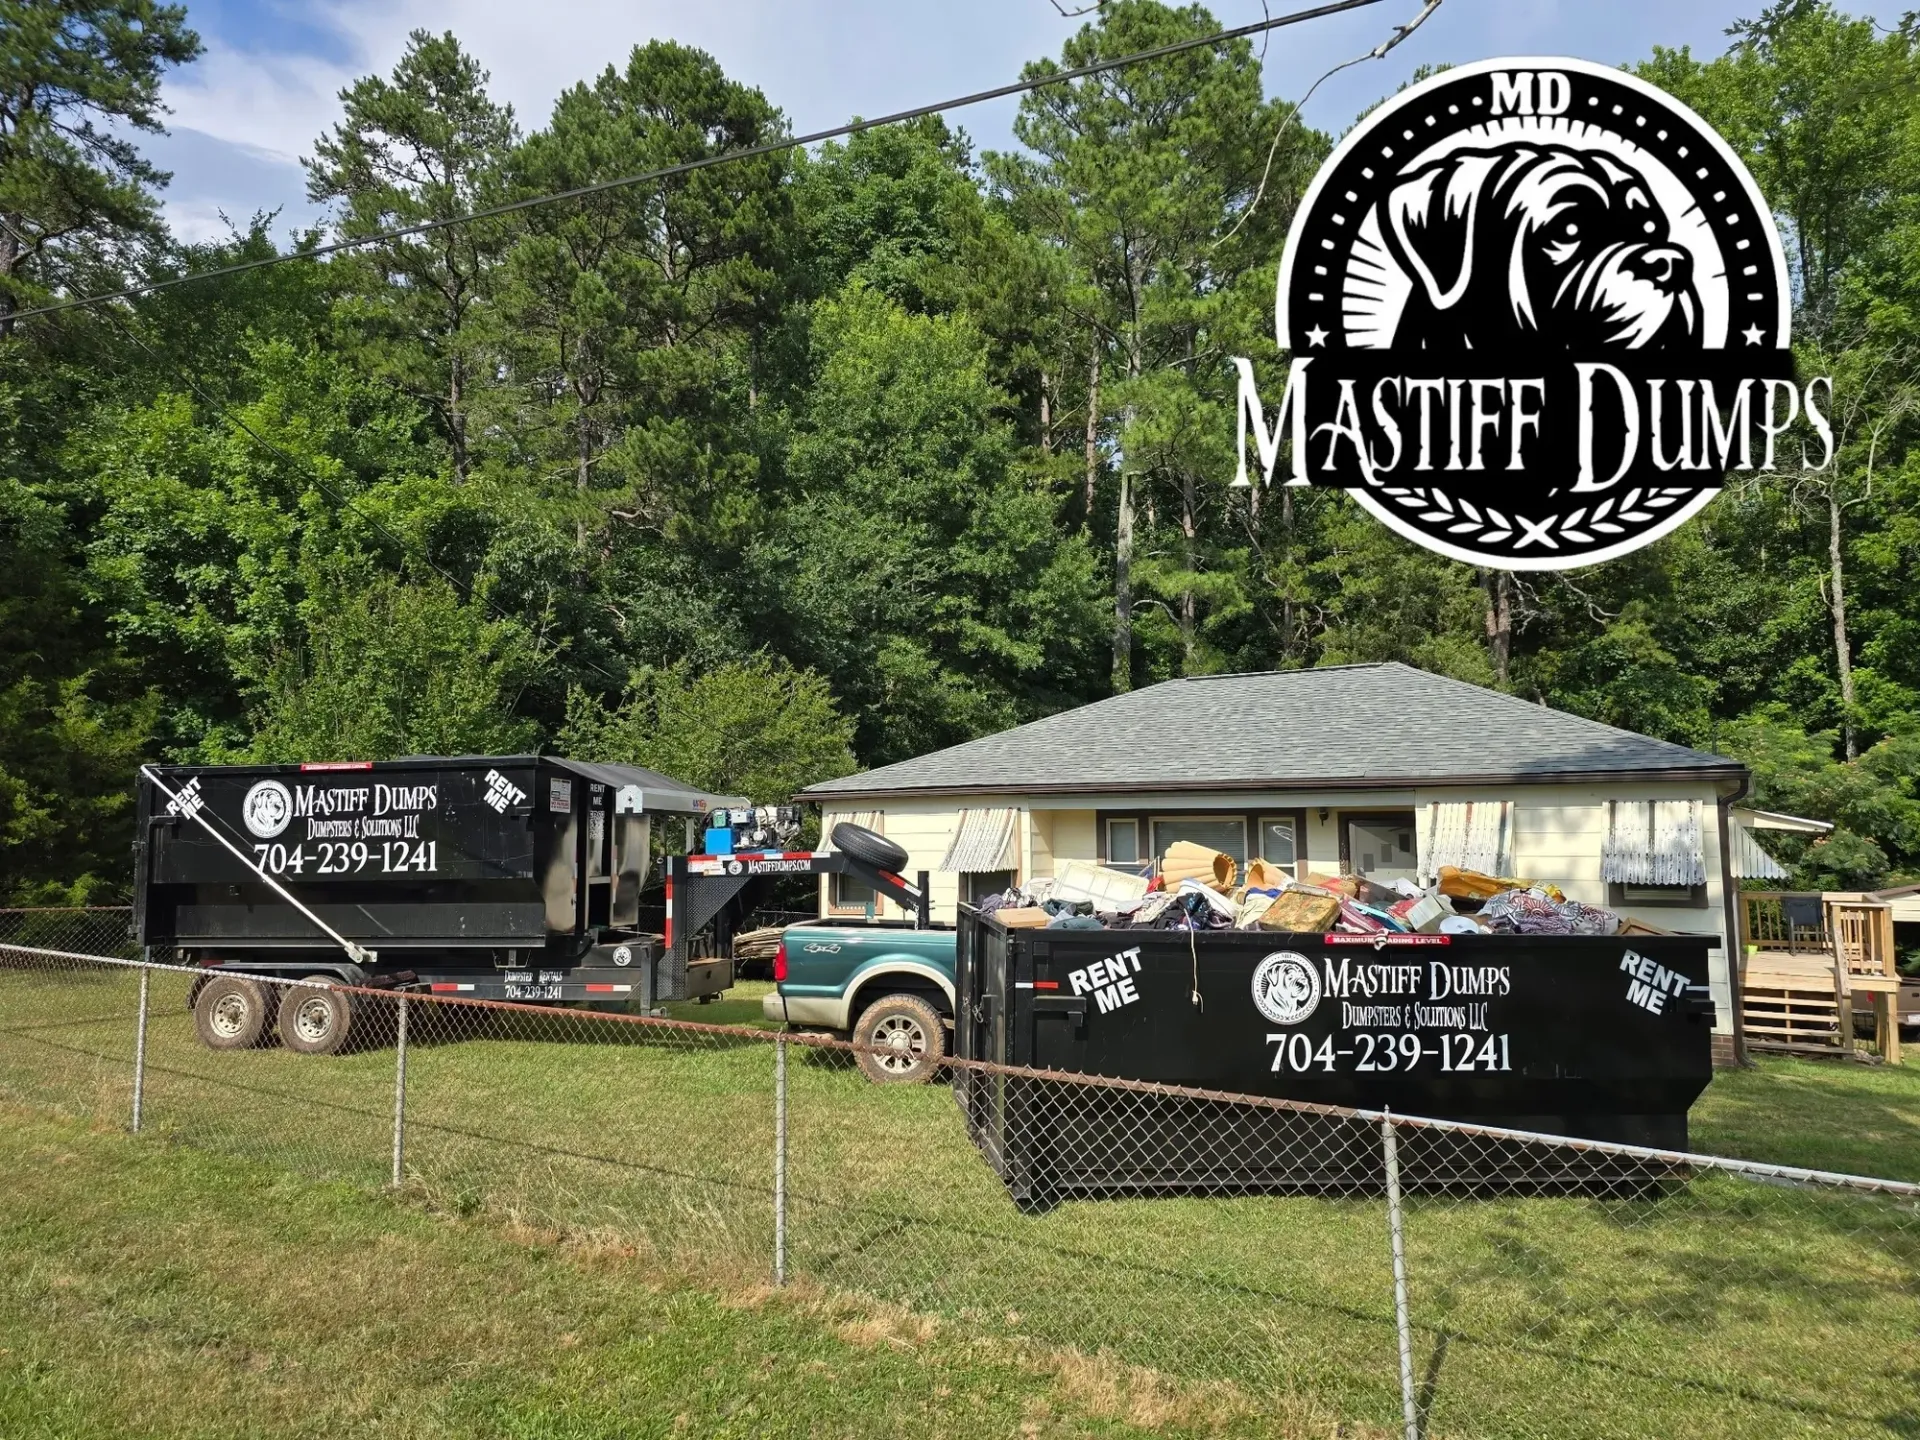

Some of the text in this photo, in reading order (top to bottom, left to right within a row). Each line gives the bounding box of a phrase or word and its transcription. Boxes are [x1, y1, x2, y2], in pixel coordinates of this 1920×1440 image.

[166, 776, 202, 817] RENT
[293, 783, 437, 817] MASTIFF DUMPS
[483, 787, 510, 814] ME
[484, 768, 527, 805] RENT
[590, 783, 605, 793] RENT
[592, 796, 603, 806] ME
[181, 793, 205, 820] ME
[307, 817, 353, 840] DUMPSTERS
[361, 815, 403, 840] SOLUTIONS
[404, 813, 420, 839] LLC
[253, 840, 438, 874] 704-239-1241
[747, 859, 811, 874] MASTIFFDUMPS.COM
[1387, 936, 1414, 944] ADING
[1415, 936, 1442, 944] LEVEL
[504, 969, 534, 983] DUMPSTER
[1068, 946, 1142, 997] RENT
[1323, 957, 1510, 1000] MASTIFF DUMPS
[1619, 948, 1691, 998] RENT
[504, 984, 563, 998] 704-239-1241
[1094, 977, 1140, 1015] ME
[1625, 978, 1667, 1016] ME
[1342, 1001, 1401, 1030] DUMPSTERS
[1413, 1000, 1466, 1031] SOLUTIONS
[1469, 1001, 1488, 1032] LLC
[1265, 1033, 1513, 1072] 704-239-1241
